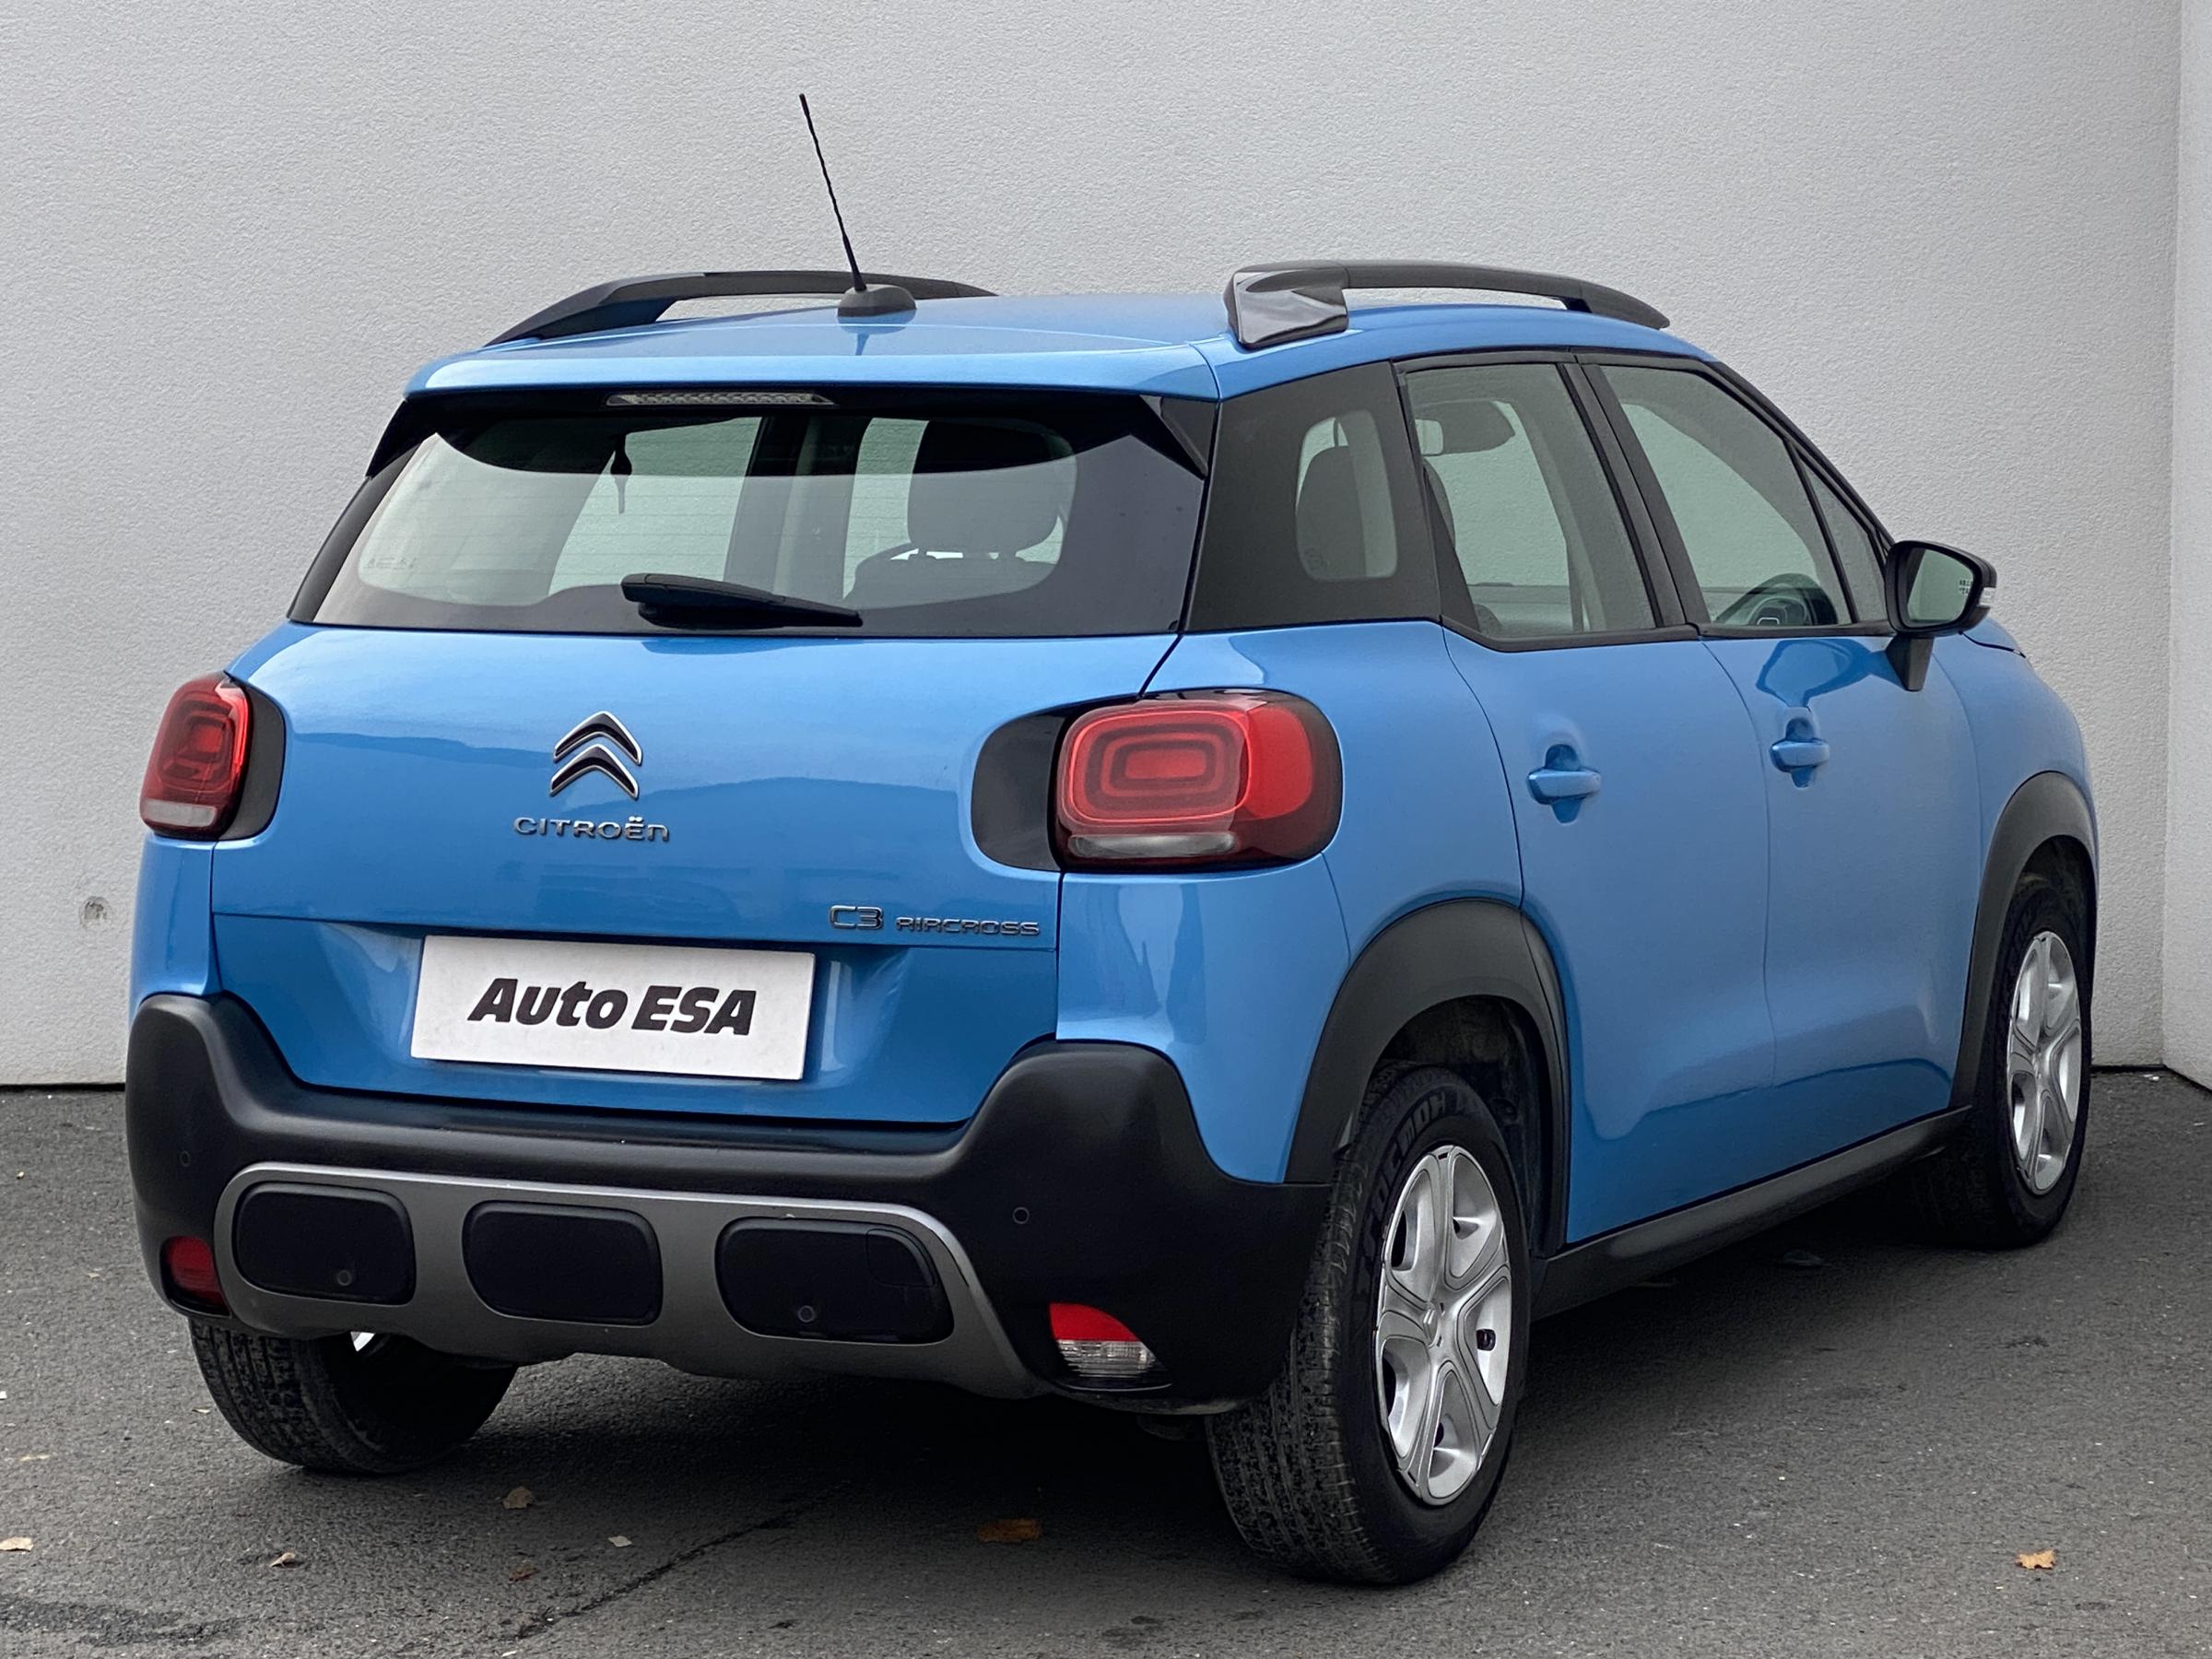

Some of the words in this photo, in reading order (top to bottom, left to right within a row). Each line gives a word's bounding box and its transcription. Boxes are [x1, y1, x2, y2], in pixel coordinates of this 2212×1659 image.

[830, 904, 884, 930] C3
[895, 916, 1041, 936] AIRCROSS
[466, 977, 629, 1030] Auto
[630, 984, 757, 1036] ESA
